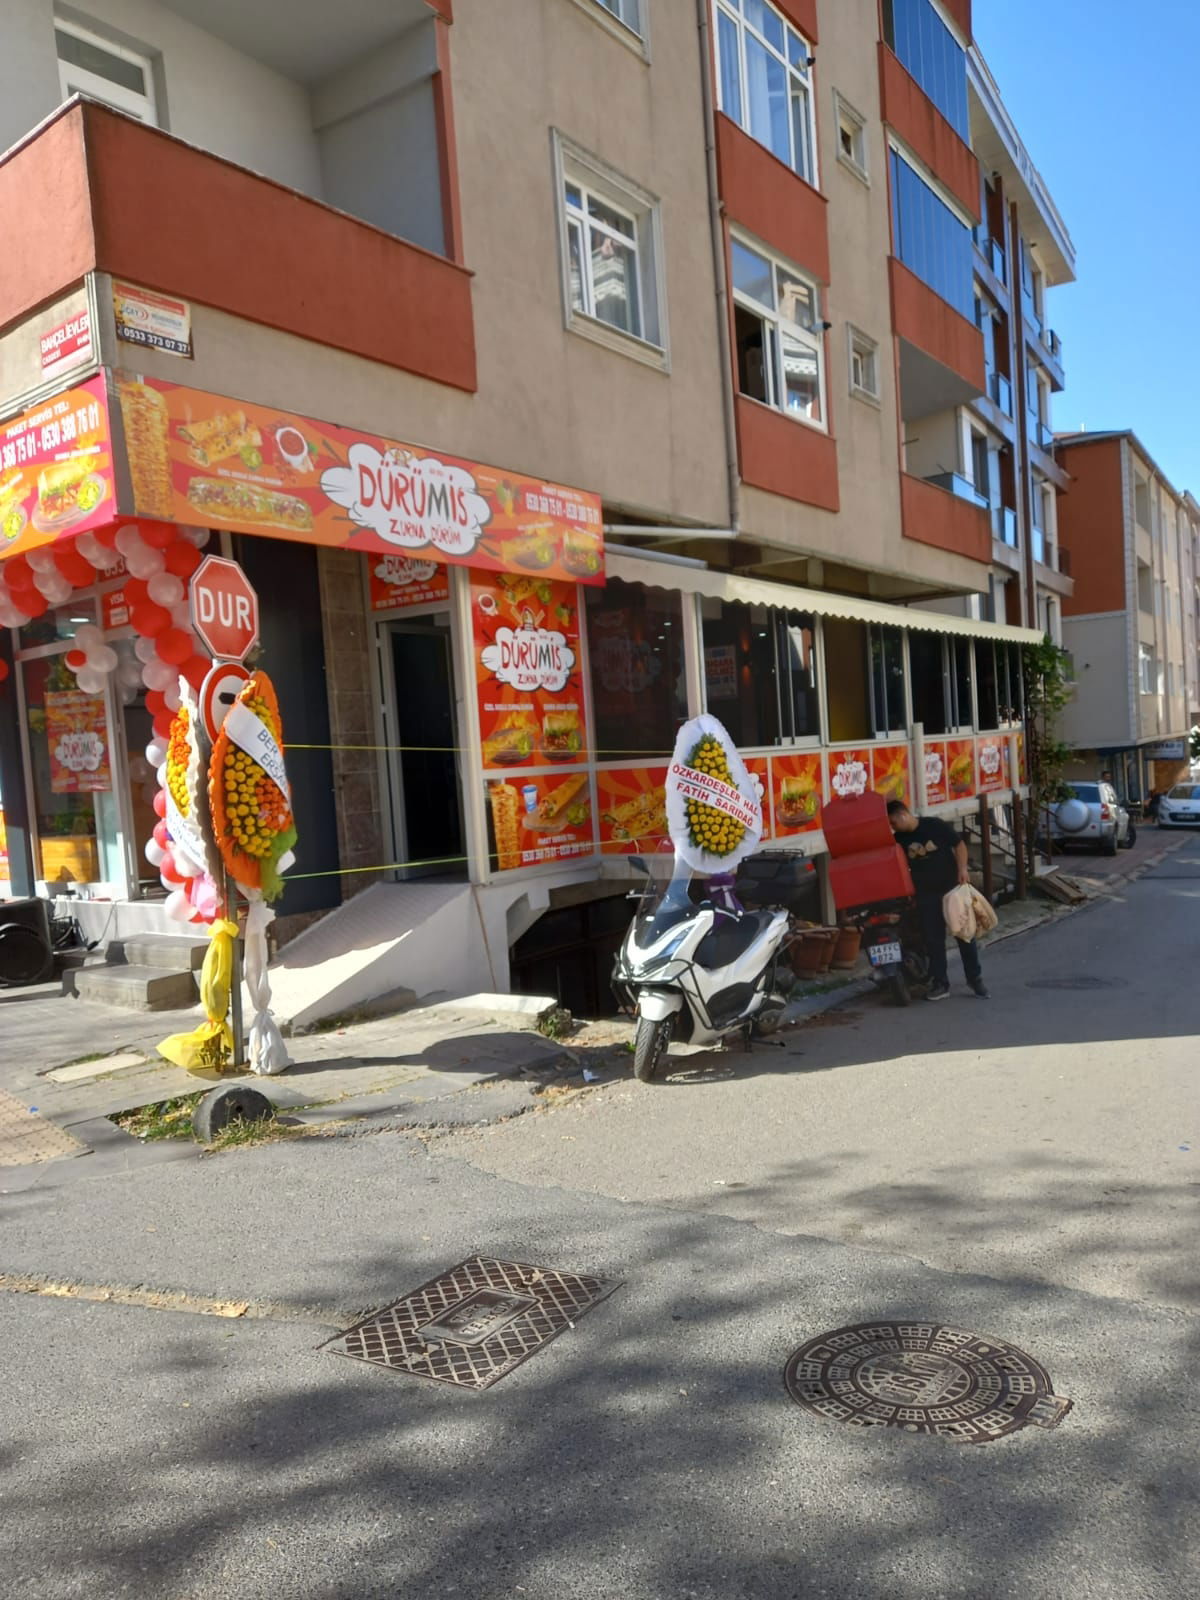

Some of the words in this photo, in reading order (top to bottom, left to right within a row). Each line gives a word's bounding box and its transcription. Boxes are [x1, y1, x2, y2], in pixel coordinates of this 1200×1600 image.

[198, 586, 253, 632] DUR
[676, 782, 710, 801] FATİH
[743, 800, 759, 817] HAL
